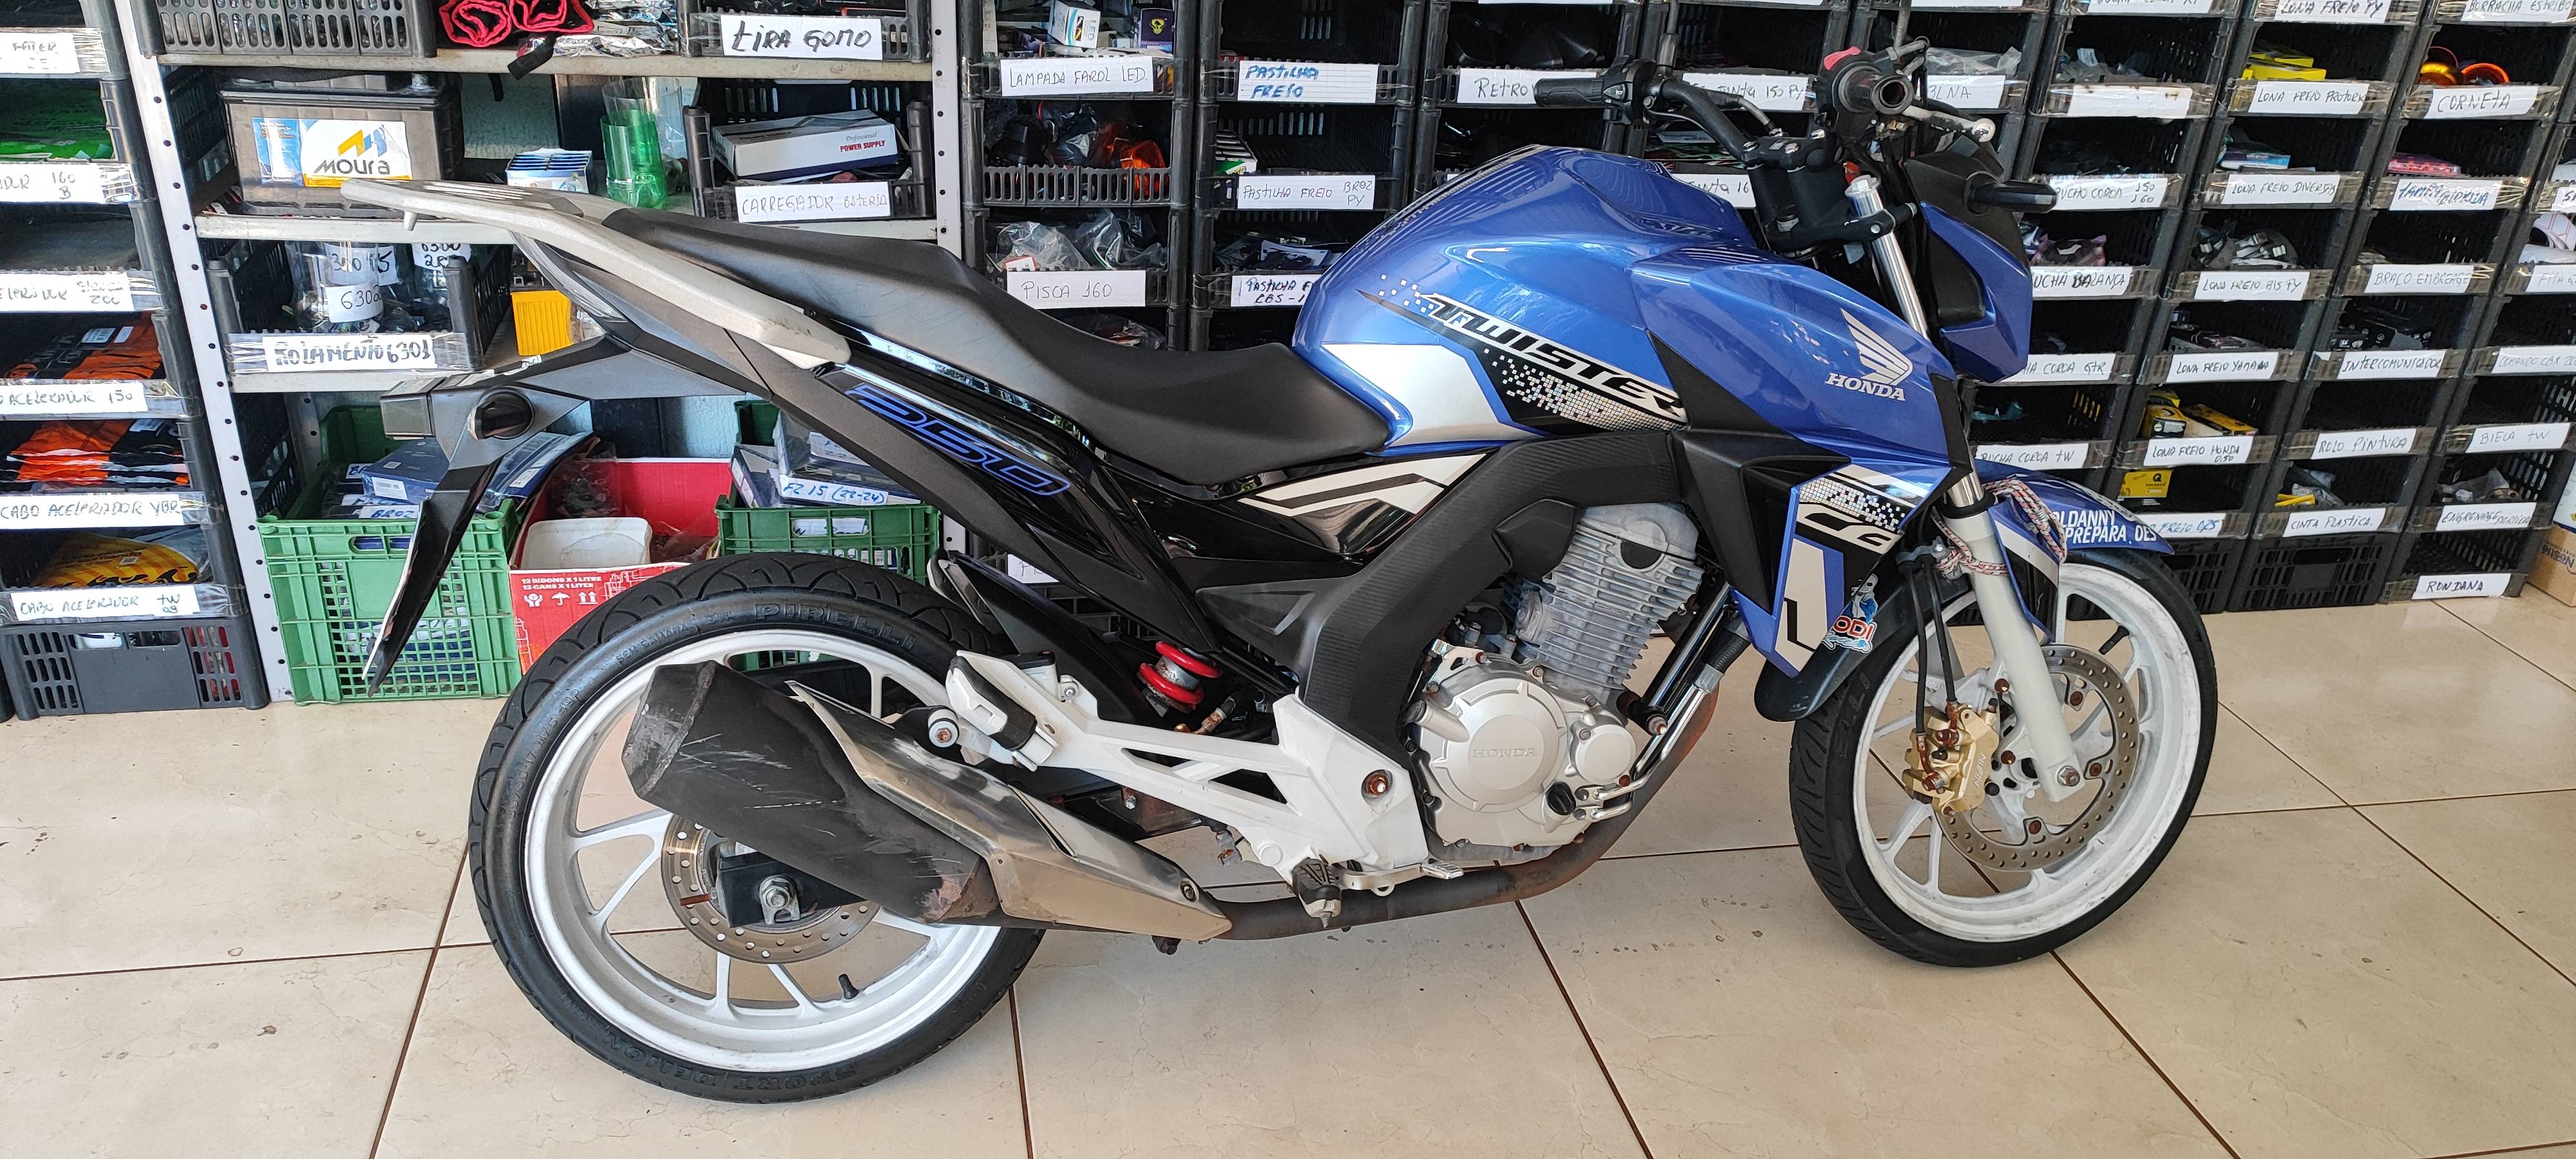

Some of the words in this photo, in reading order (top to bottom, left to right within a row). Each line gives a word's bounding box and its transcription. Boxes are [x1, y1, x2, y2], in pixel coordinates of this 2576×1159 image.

[1075, 67, 1109, 84] FAROL
[2258, 88, 2285, 102] LONA
[840, 144, 862, 152] POWER
[863, 140, 886, 149] SUPPLY
[2232, 183, 2255, 194] LONA
[2260, 181, 2289, 193] FREIO
[743, 195, 834, 215] CARREGADOR
[2033, 272, 2068, 288] UCHA
[1082, 281, 1112, 298] 160
[1421, 294, 1687, 419] TWISTER
[2176, 361, 2198, 374] LONA
[1824, 371, 1906, 402] HONDA
[2152, 446, 2176, 458] LONA
[2318, 440, 2344, 453] ROLO
[808, 484, 829, 496] 15
[1, 505, 40, 520] CABO
[2291, 518, 2318, 530] CINTA
[2425, 580, 2483, 593] RONDANA
[754, 603, 917, 651] PIRELLI
[1472, 748, 1539, 759] HONDA
